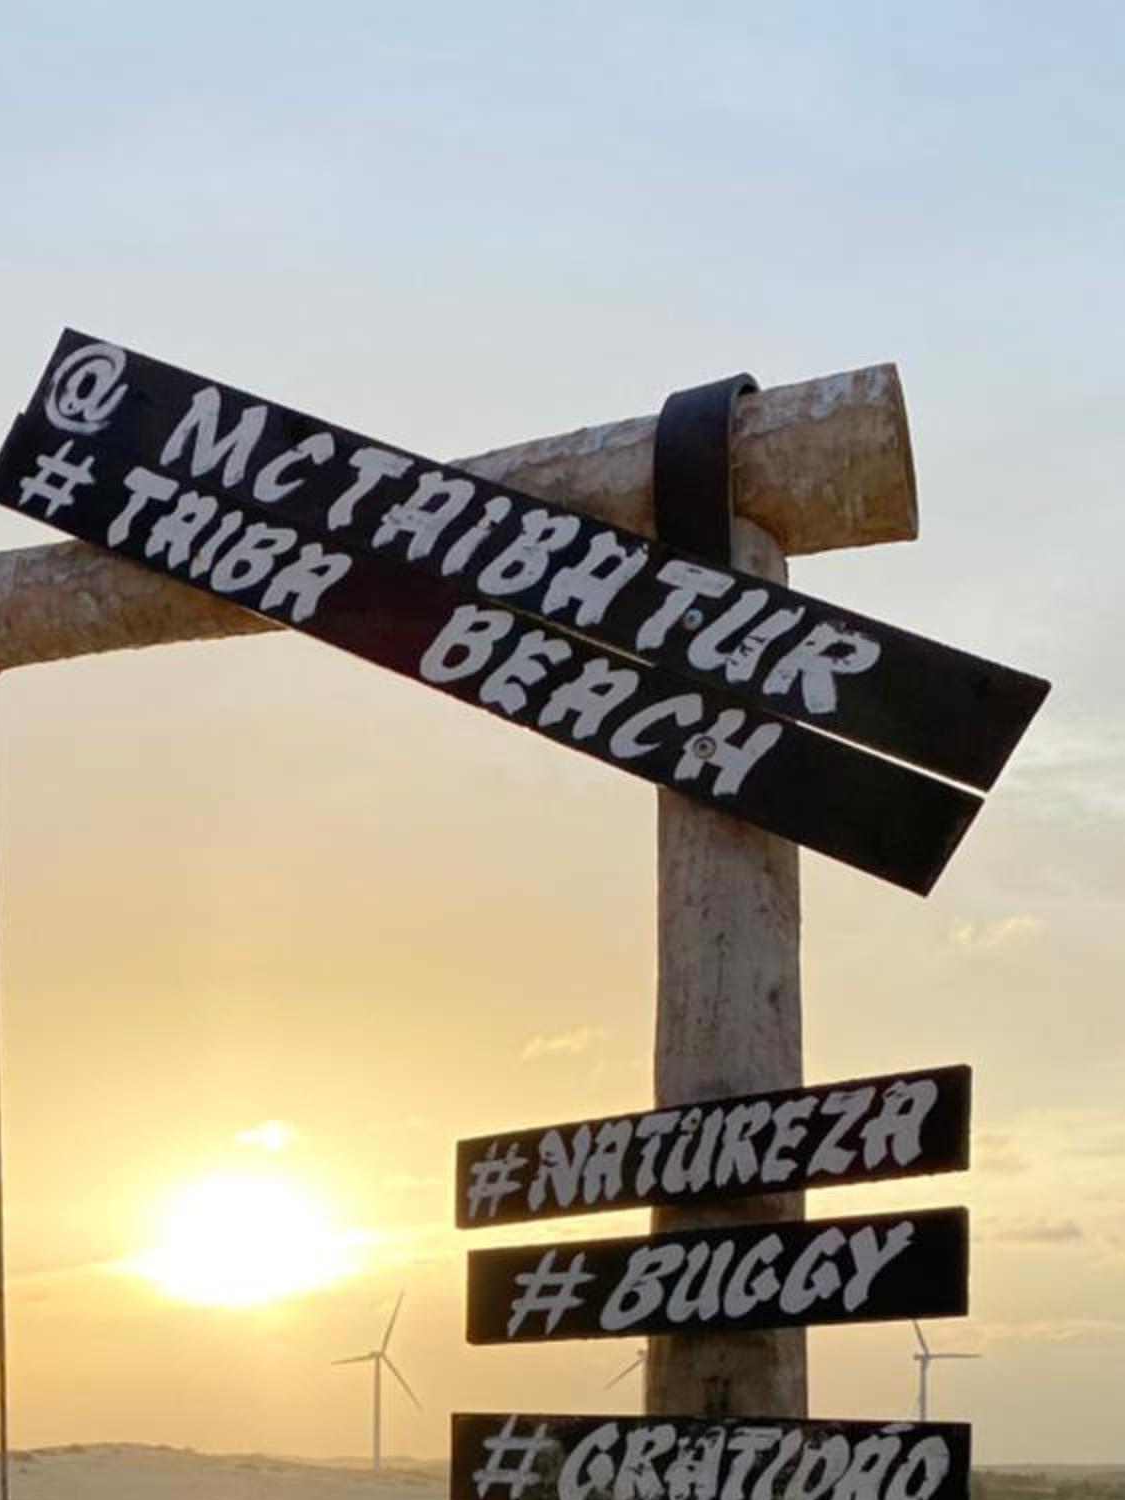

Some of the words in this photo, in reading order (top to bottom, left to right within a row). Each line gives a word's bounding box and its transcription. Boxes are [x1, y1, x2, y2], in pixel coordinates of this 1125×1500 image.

[45, 342, 128, 435] @
[19, 440, 95, 517] #
[419, 603, 783, 796] BEACH
[468, 1078, 938, 1218] #NATUREZA
